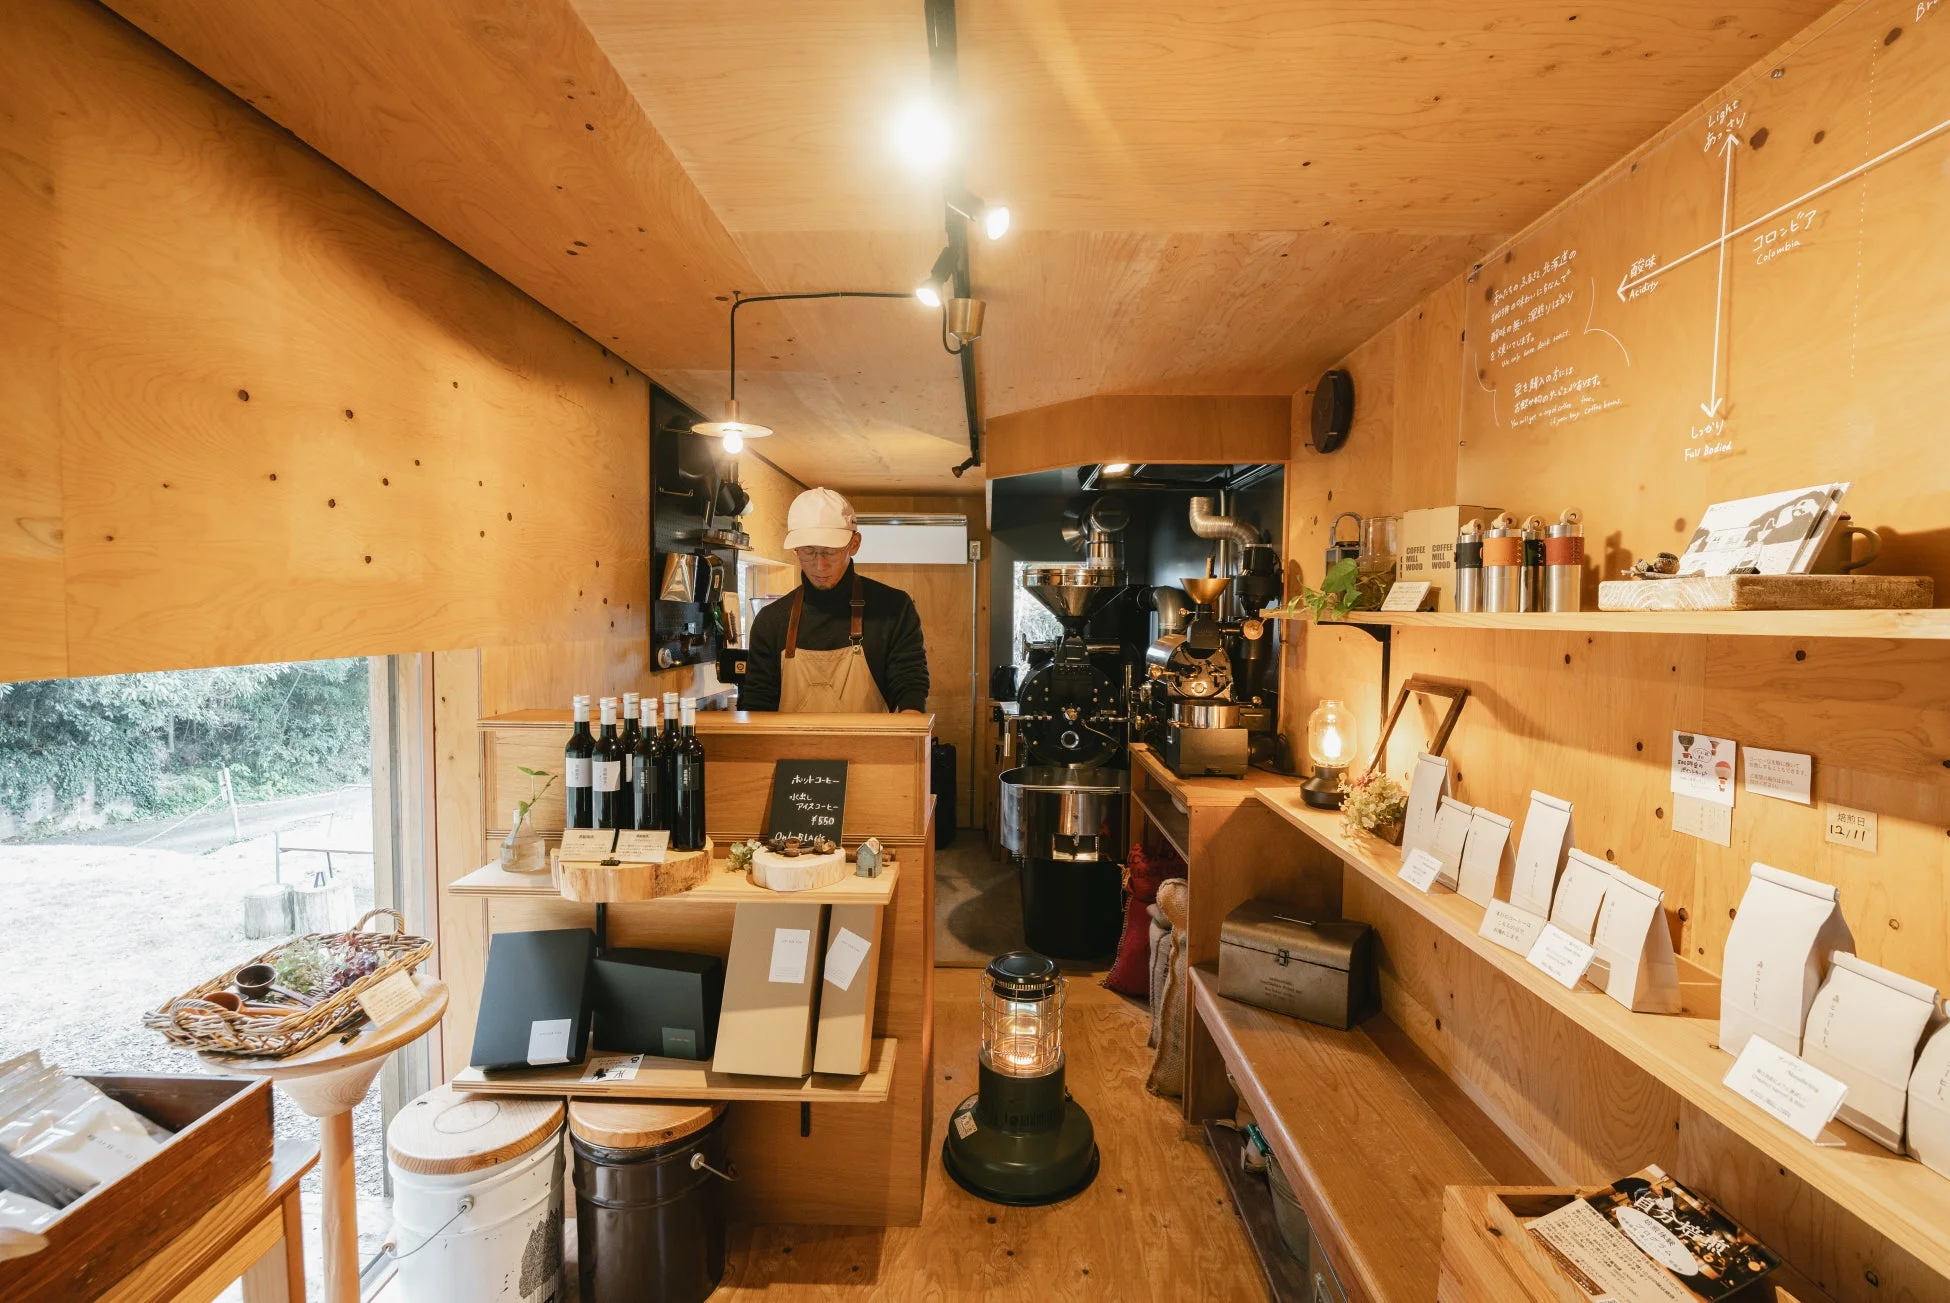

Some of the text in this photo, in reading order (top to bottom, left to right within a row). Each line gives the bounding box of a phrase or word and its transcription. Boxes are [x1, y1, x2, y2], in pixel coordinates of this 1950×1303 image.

[1708, 100, 1739, 128] Light
[1703, 112, 1746, 153] あっさり
[1753, 210, 1817, 252] コロンビア
[1756, 240, 1801, 265] Colombia
[1630, 254, 1657, 278] 酸味
[1628, 280, 1659, 302] Acidity
[1691, 419, 1724, 440] しっかり
[1684, 440, 1733, 462] Full Bodied
[1406, 545, 1426, 555] COFFEE
[1431, 543, 1454, 553] COFFEE
[1406, 554, 1418, 563] MILL
[1431, 552, 1445, 561] MILL
[1405, 563, 1423, 571] WOOD
[1431, 561, 1451, 570] WOOD
[791, 774, 840, 785] ホットコーヒー
[789, 791, 813, 801] 水出し
[796, 802, 839, 811] アイスコーヒー
[811, 815, 835, 826] ¥550
[1838, 812, 1865, 827] 焙煎日
[1830, 824, 1866, 842] 12/11
